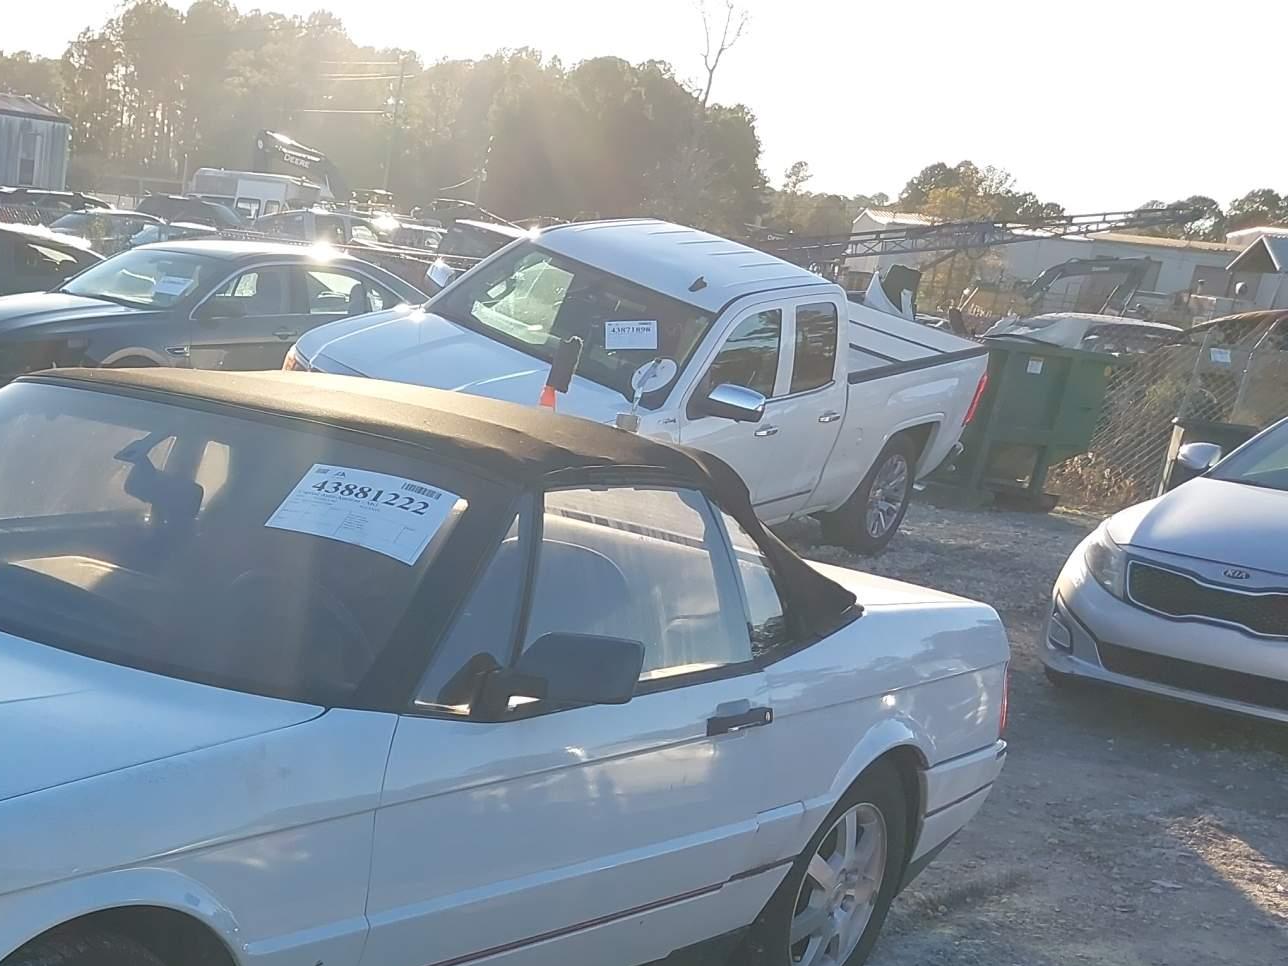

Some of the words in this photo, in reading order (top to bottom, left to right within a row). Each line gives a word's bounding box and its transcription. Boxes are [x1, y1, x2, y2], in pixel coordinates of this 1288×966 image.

[283, 153, 311, 168] DEERE
[312, 480, 430, 515] 43881222
[1225, 569, 1247, 579] KIA
